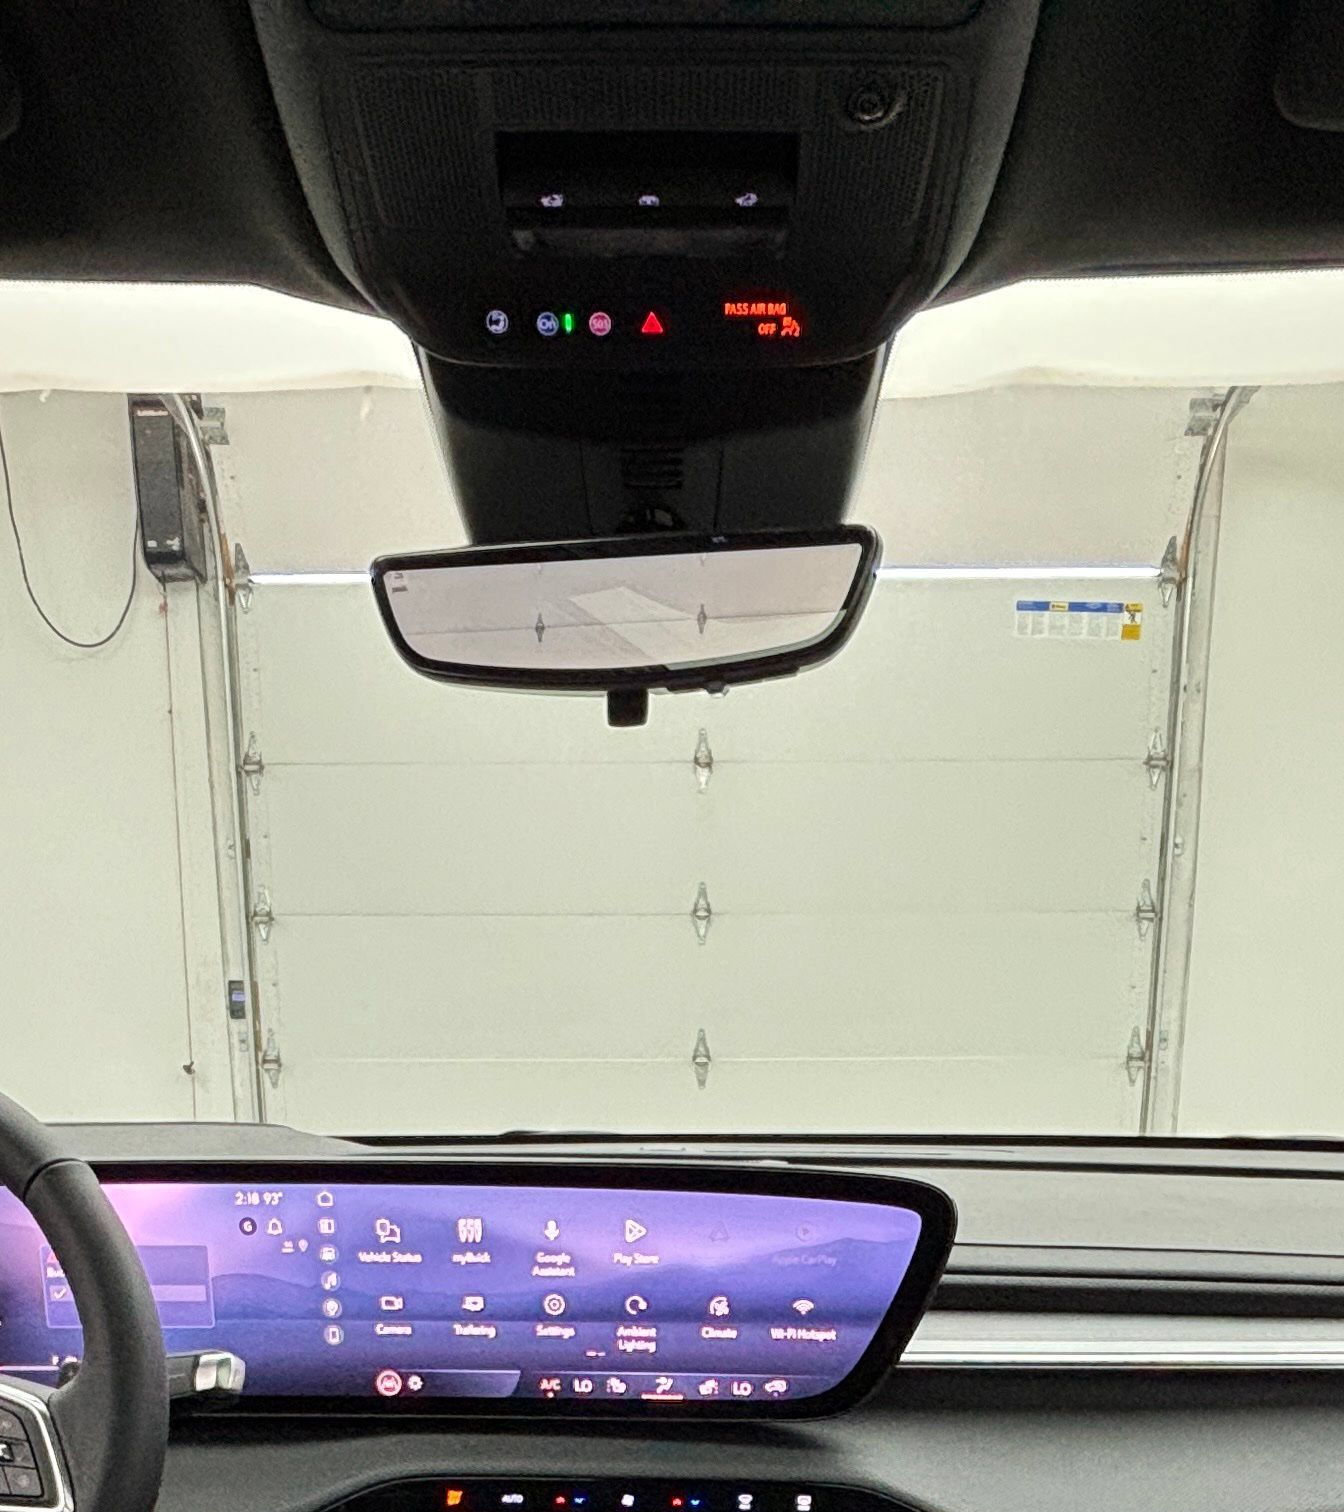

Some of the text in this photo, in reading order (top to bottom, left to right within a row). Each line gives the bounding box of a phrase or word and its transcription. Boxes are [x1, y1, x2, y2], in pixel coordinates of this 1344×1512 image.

[724, 302, 787, 315] PASS AIR BAG
[758, 322, 777, 335] OFF
[613, 1252, 633, 1267] Play
[573, 1378, 593, 1393] LO
[731, 1381, 752, 1396] LO
